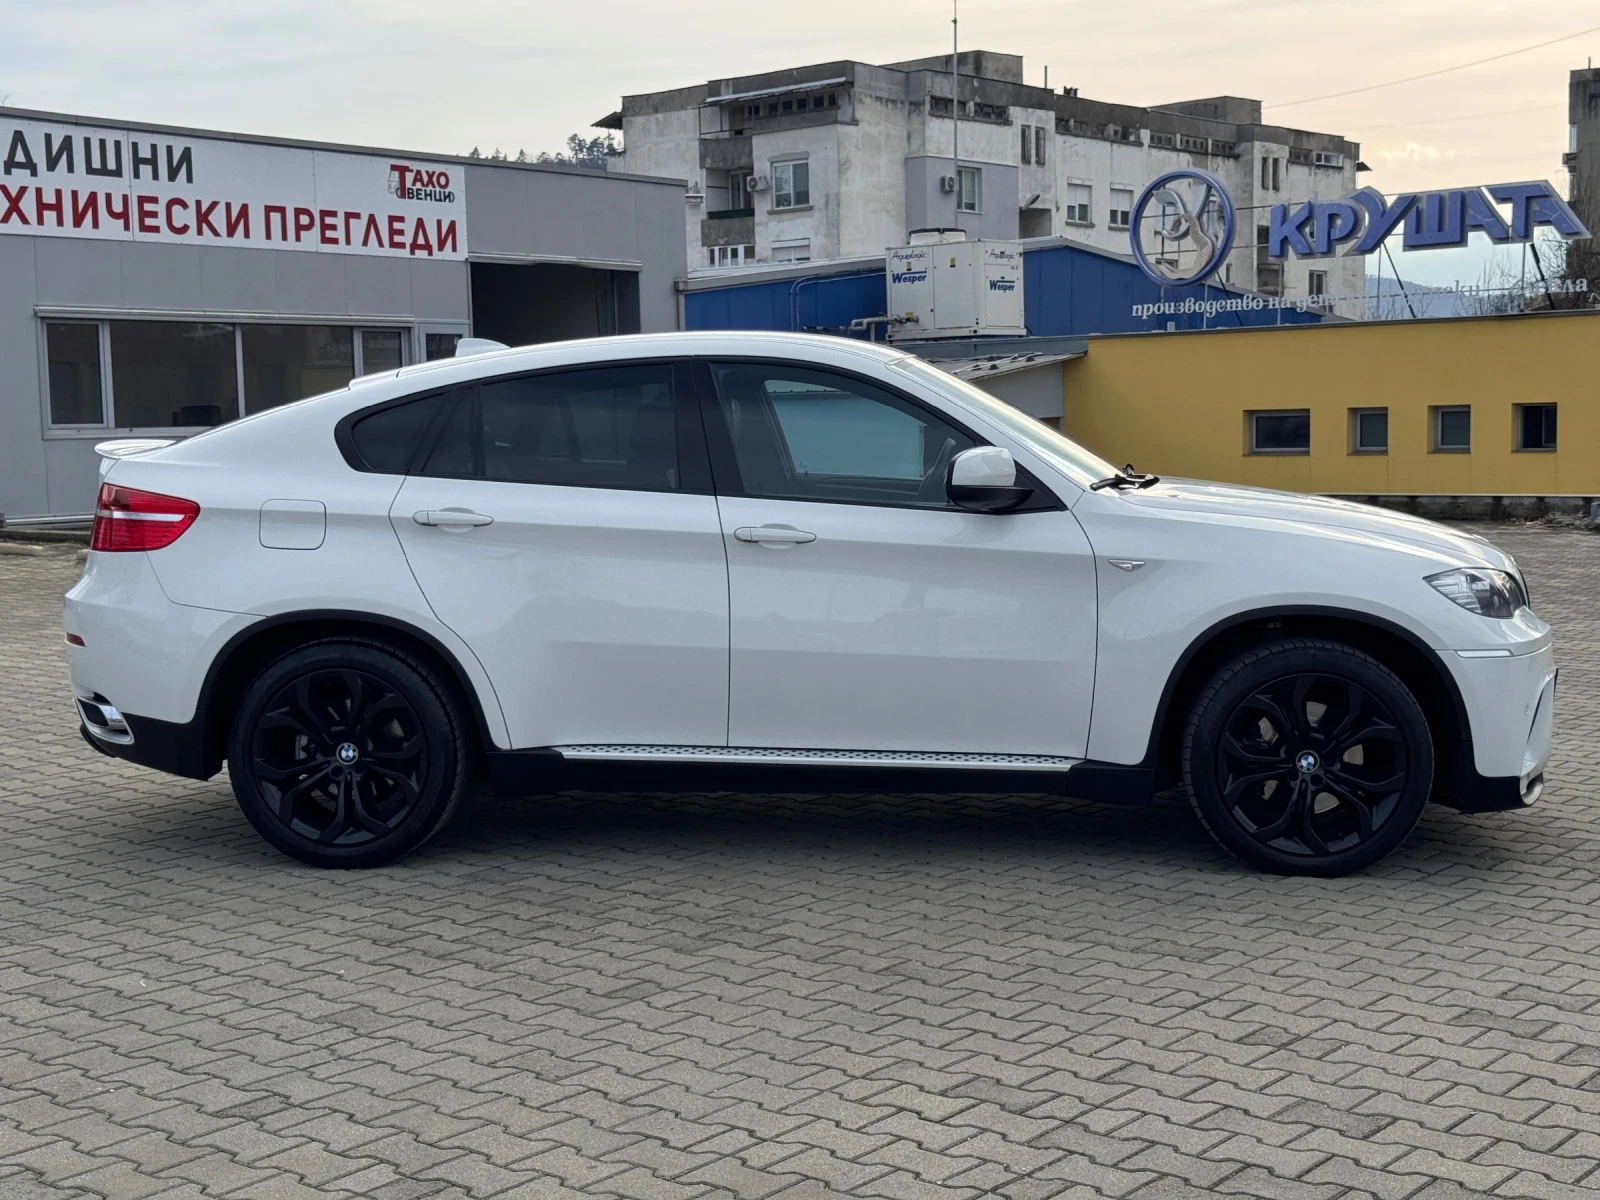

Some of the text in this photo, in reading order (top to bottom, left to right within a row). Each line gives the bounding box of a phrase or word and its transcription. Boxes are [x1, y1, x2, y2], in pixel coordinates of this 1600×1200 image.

[3, 129, 194, 184] ДИШНИ
[390, 164, 450, 199] ТАХО
[0, 184, 458, 256] ХНИЧЕСКИ ПРЕГЛЕДИ
[1268, 182, 1581, 258] КРУШАТА
[892, 271, 928, 284] Wesper
[989, 280, 1015, 293] Wesper
[1131, 293, 1263, 319] производство
[1268, 296, 1291, 309] на
